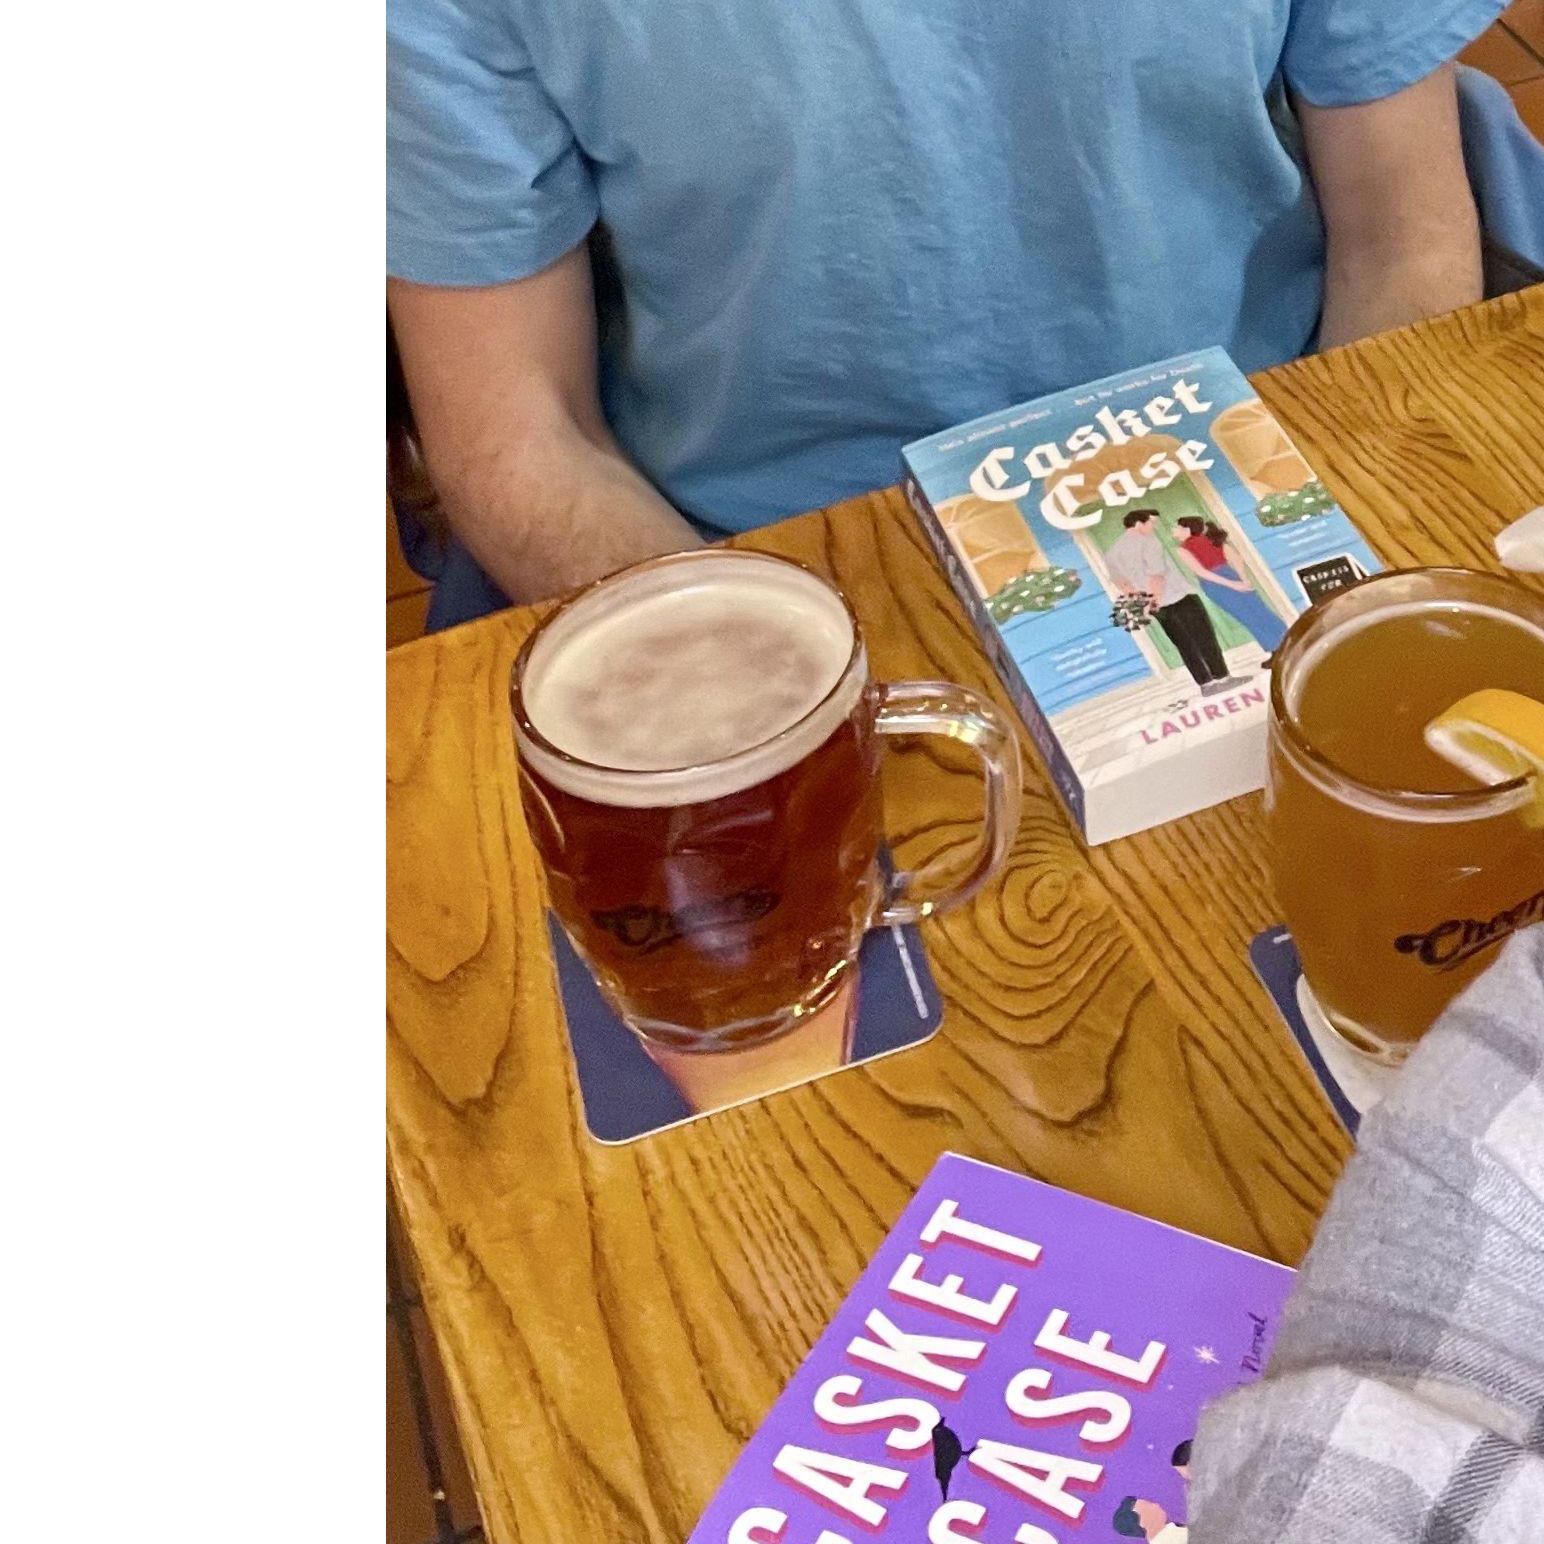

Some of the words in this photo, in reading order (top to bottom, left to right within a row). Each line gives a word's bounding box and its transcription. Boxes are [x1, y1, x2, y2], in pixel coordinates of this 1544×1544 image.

[969, 378, 1213, 502] Casket
[1040, 439, 1215, 531] Case
[1140, 687, 1266, 745] LAUREN
